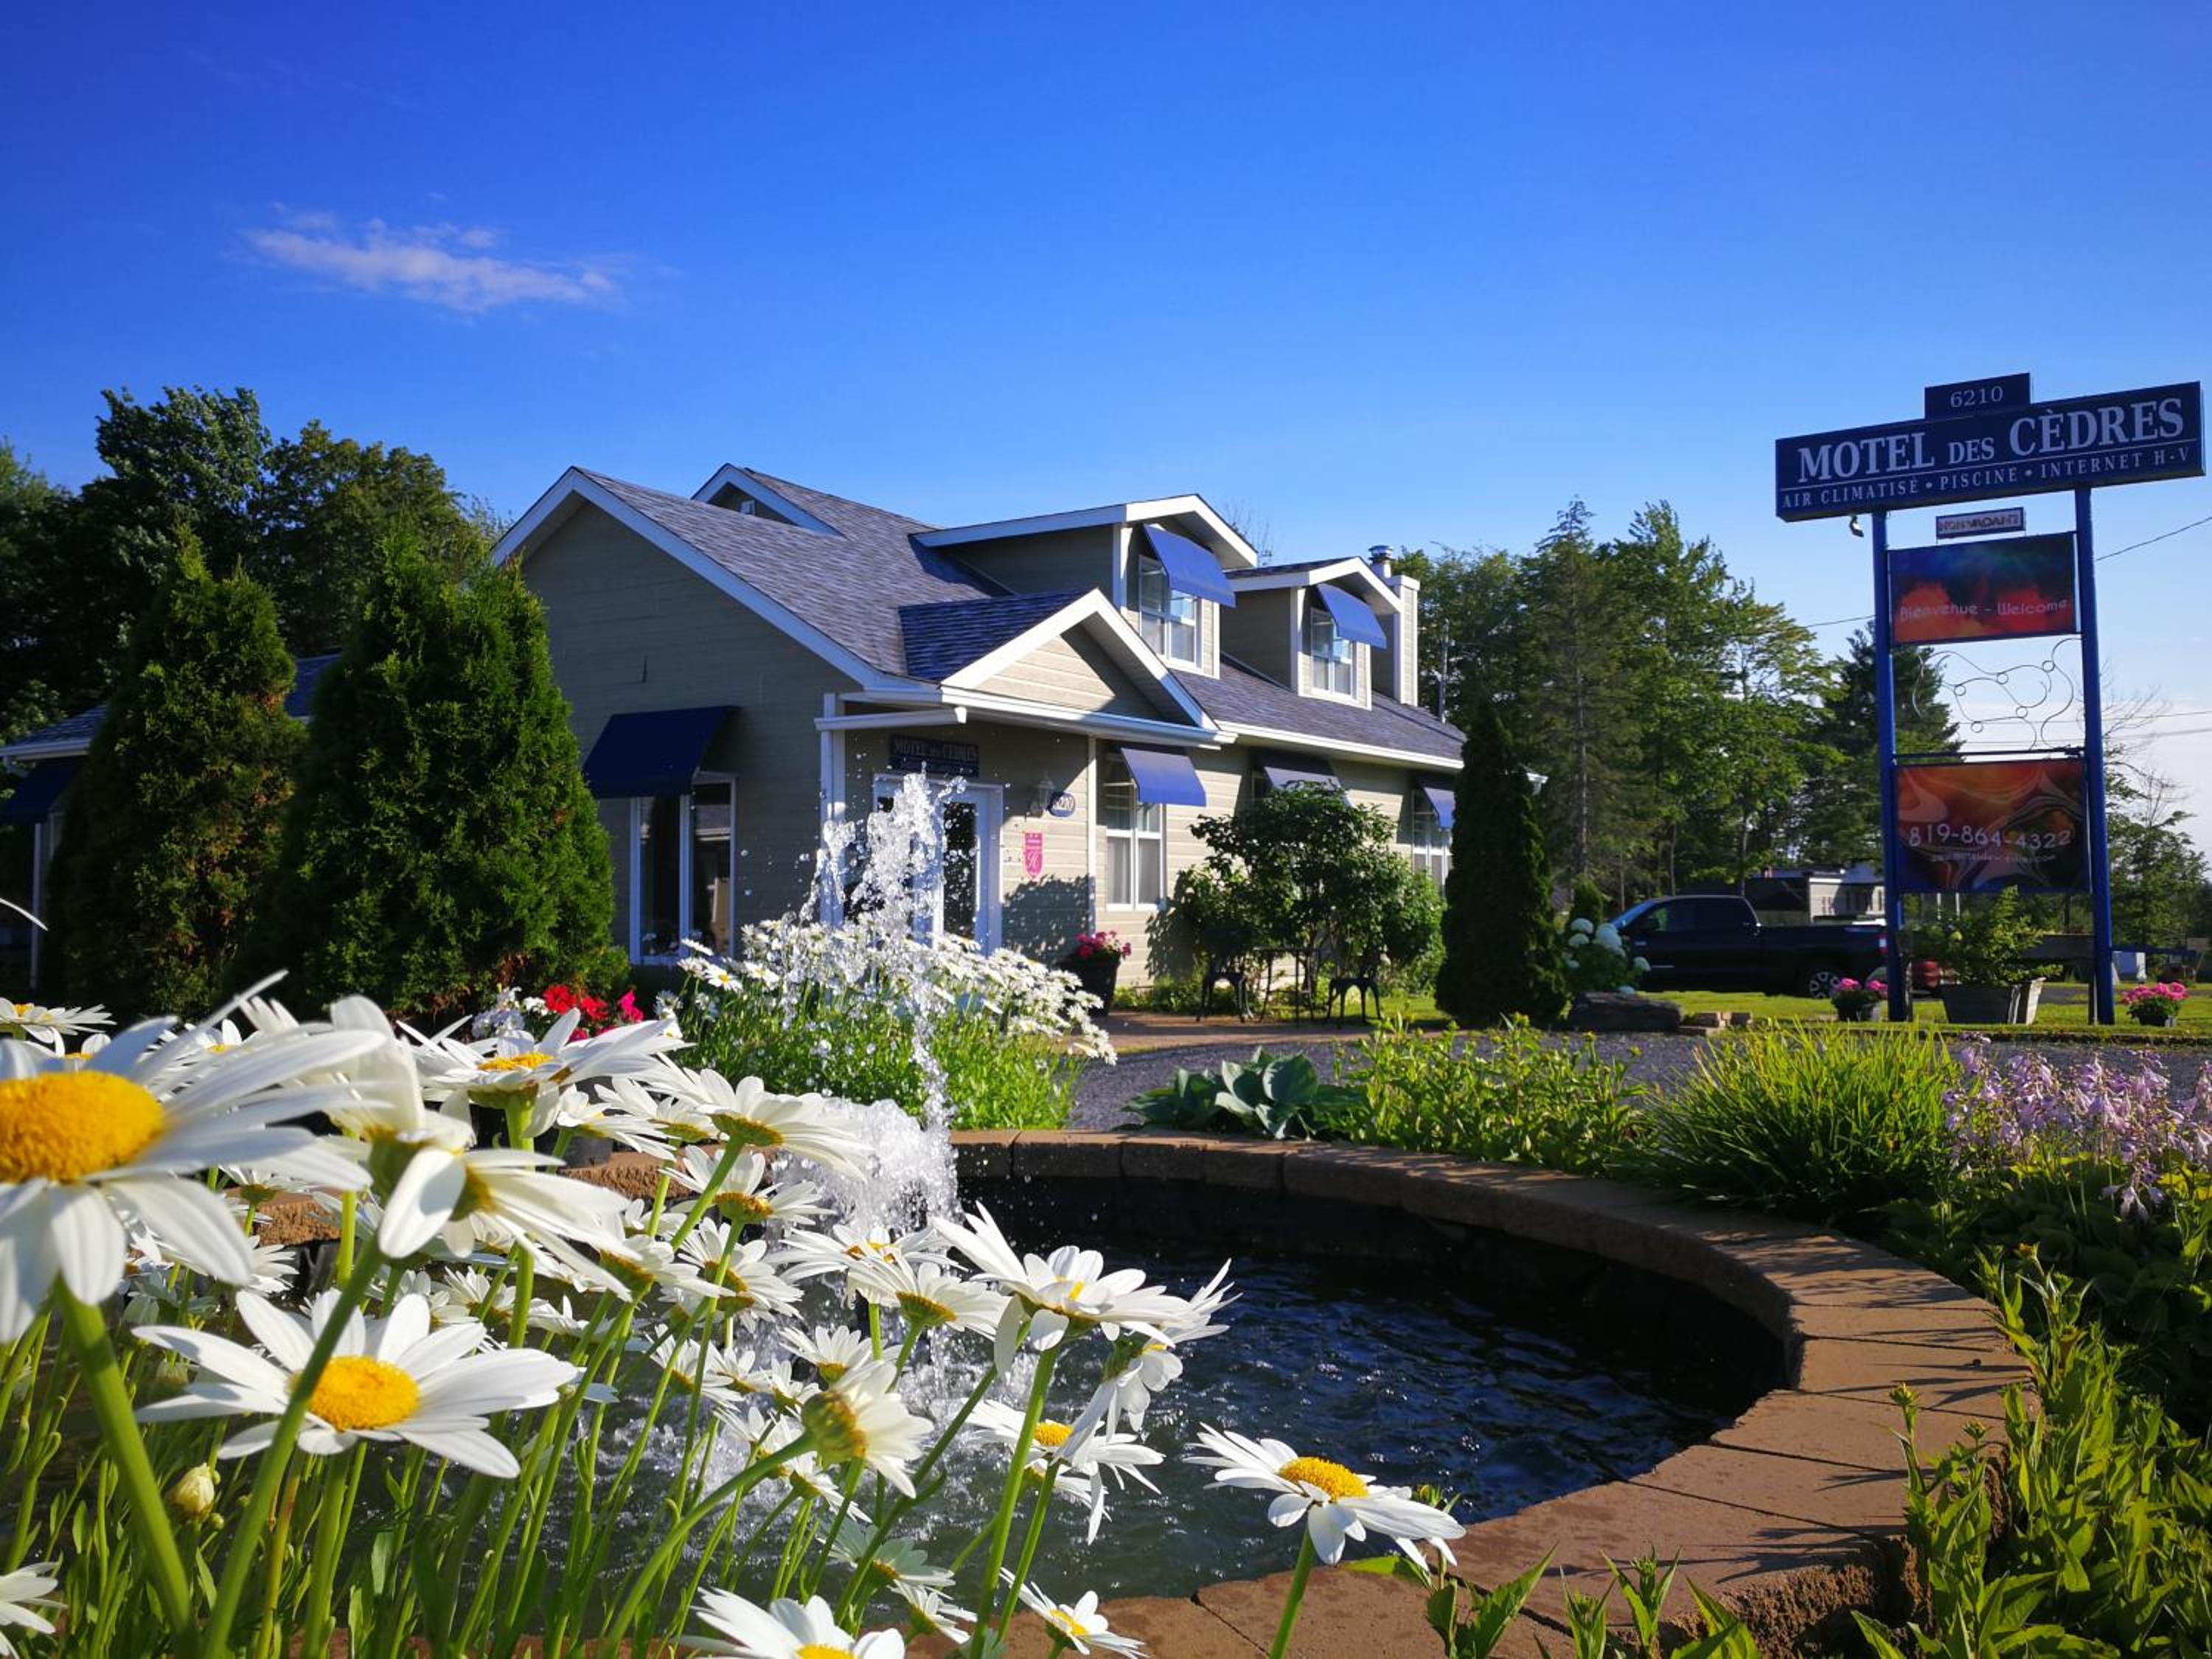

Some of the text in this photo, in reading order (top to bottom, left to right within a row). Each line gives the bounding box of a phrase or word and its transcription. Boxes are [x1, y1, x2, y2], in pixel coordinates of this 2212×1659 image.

[1950, 386, 2003, 408] 6210
[1798, 398, 2183, 483] MOTEL DES CÈDRES
[1782, 493, 1812, 508] AIR
[1940, 467, 2017, 491] PISCINE
[2041, 453, 2142, 479] INTERNET
[1900, 603, 1978, 621] Bienvenue
[1997, 599, 2067, 615] Welcome
[1909, 823, 2071, 849] 819-864-4322
